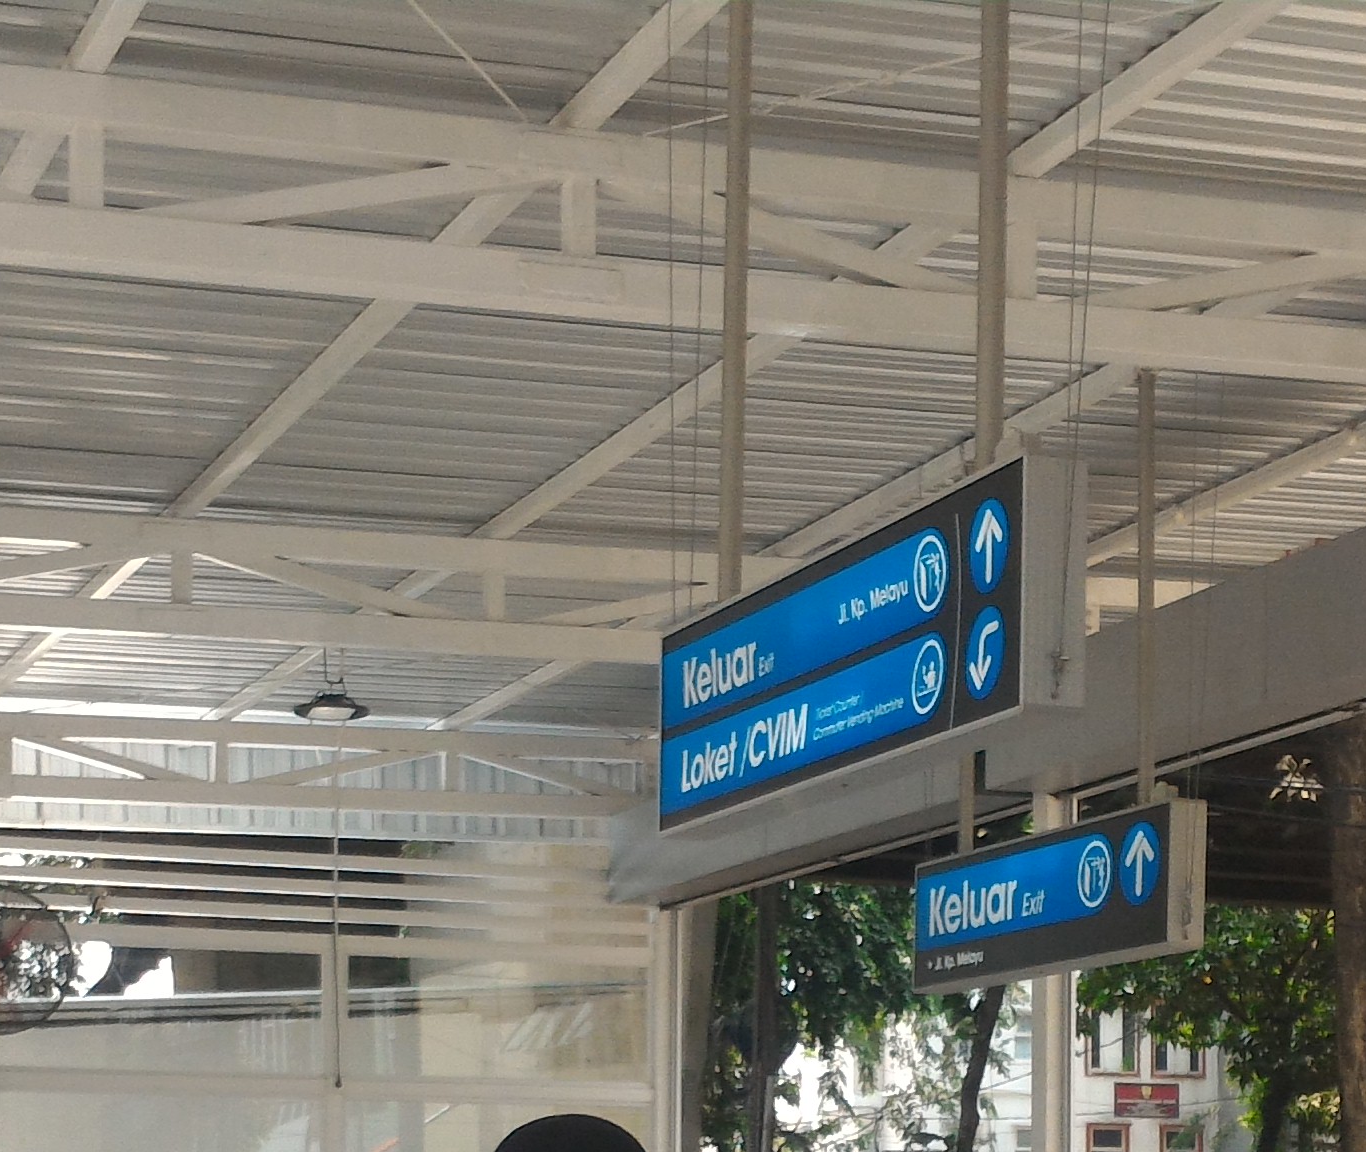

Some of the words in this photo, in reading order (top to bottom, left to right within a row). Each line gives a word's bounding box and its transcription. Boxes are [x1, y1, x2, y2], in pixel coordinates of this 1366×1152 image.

[870, 580, 908, 610] Melayu
[683, 641, 757, 708] Keluar
[681, 731, 737, 792] Loket
[929, 880, 1018, 937] Keluar
[1022, 889, 1046, 917] Exit
